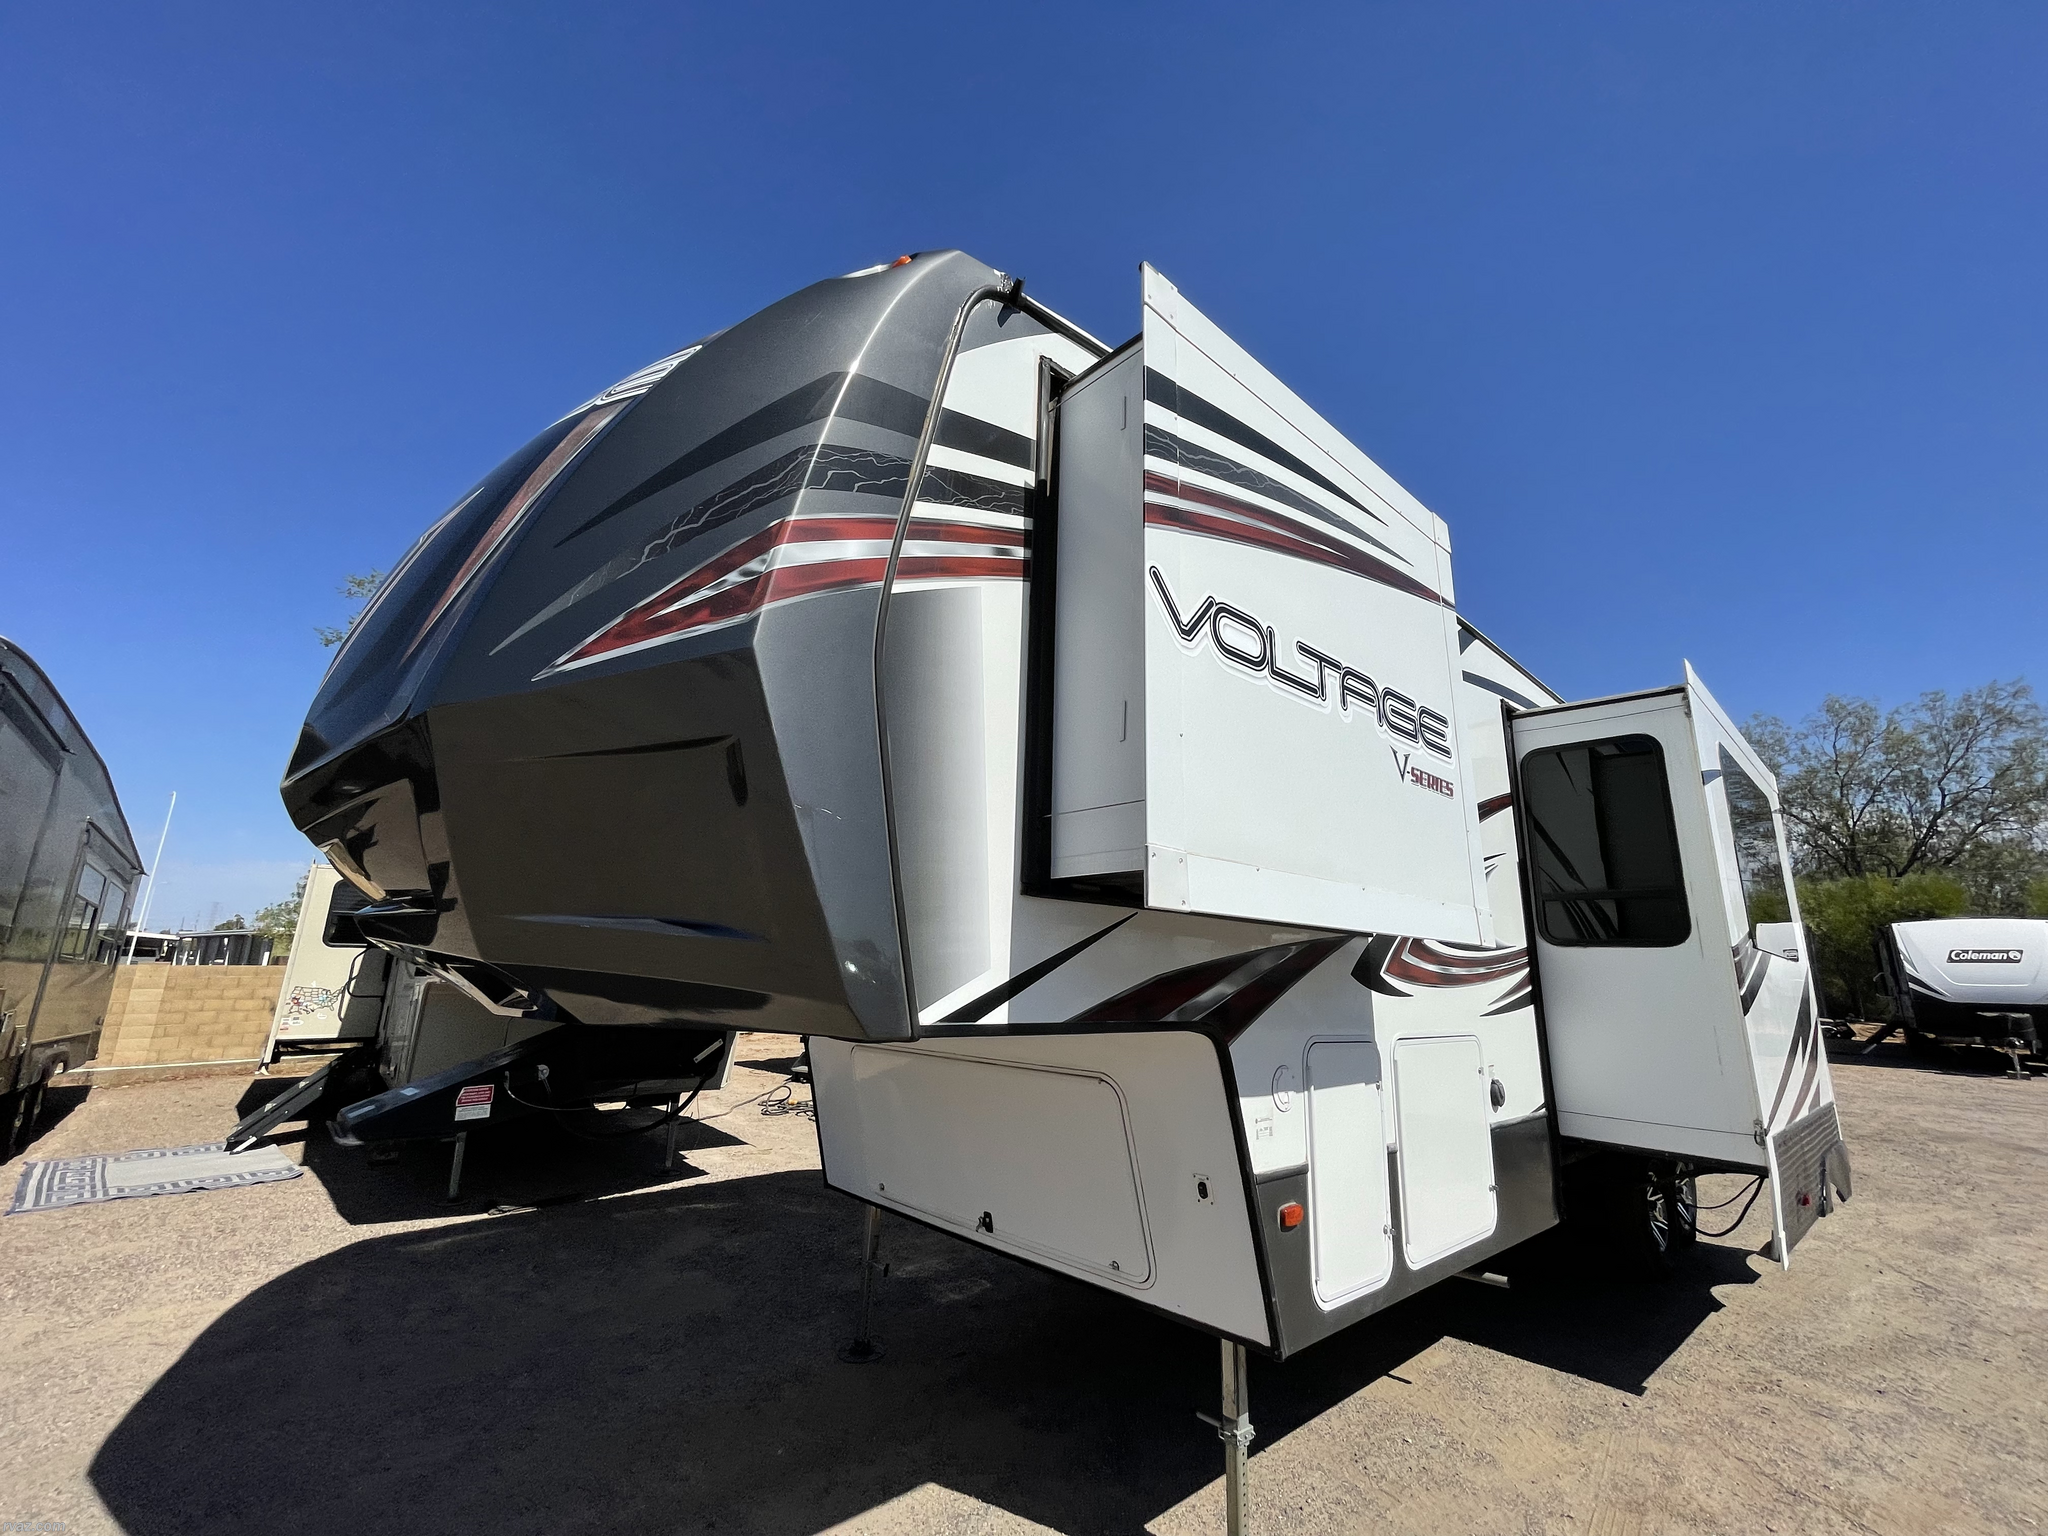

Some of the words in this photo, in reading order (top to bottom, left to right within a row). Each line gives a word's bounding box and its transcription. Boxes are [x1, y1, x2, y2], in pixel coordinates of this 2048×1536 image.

[1149, 565, 1452, 759] VOLTAGE
[1389, 744, 1454, 799] V-SERIES
[1950, 950, 2008, 961] Coleman
